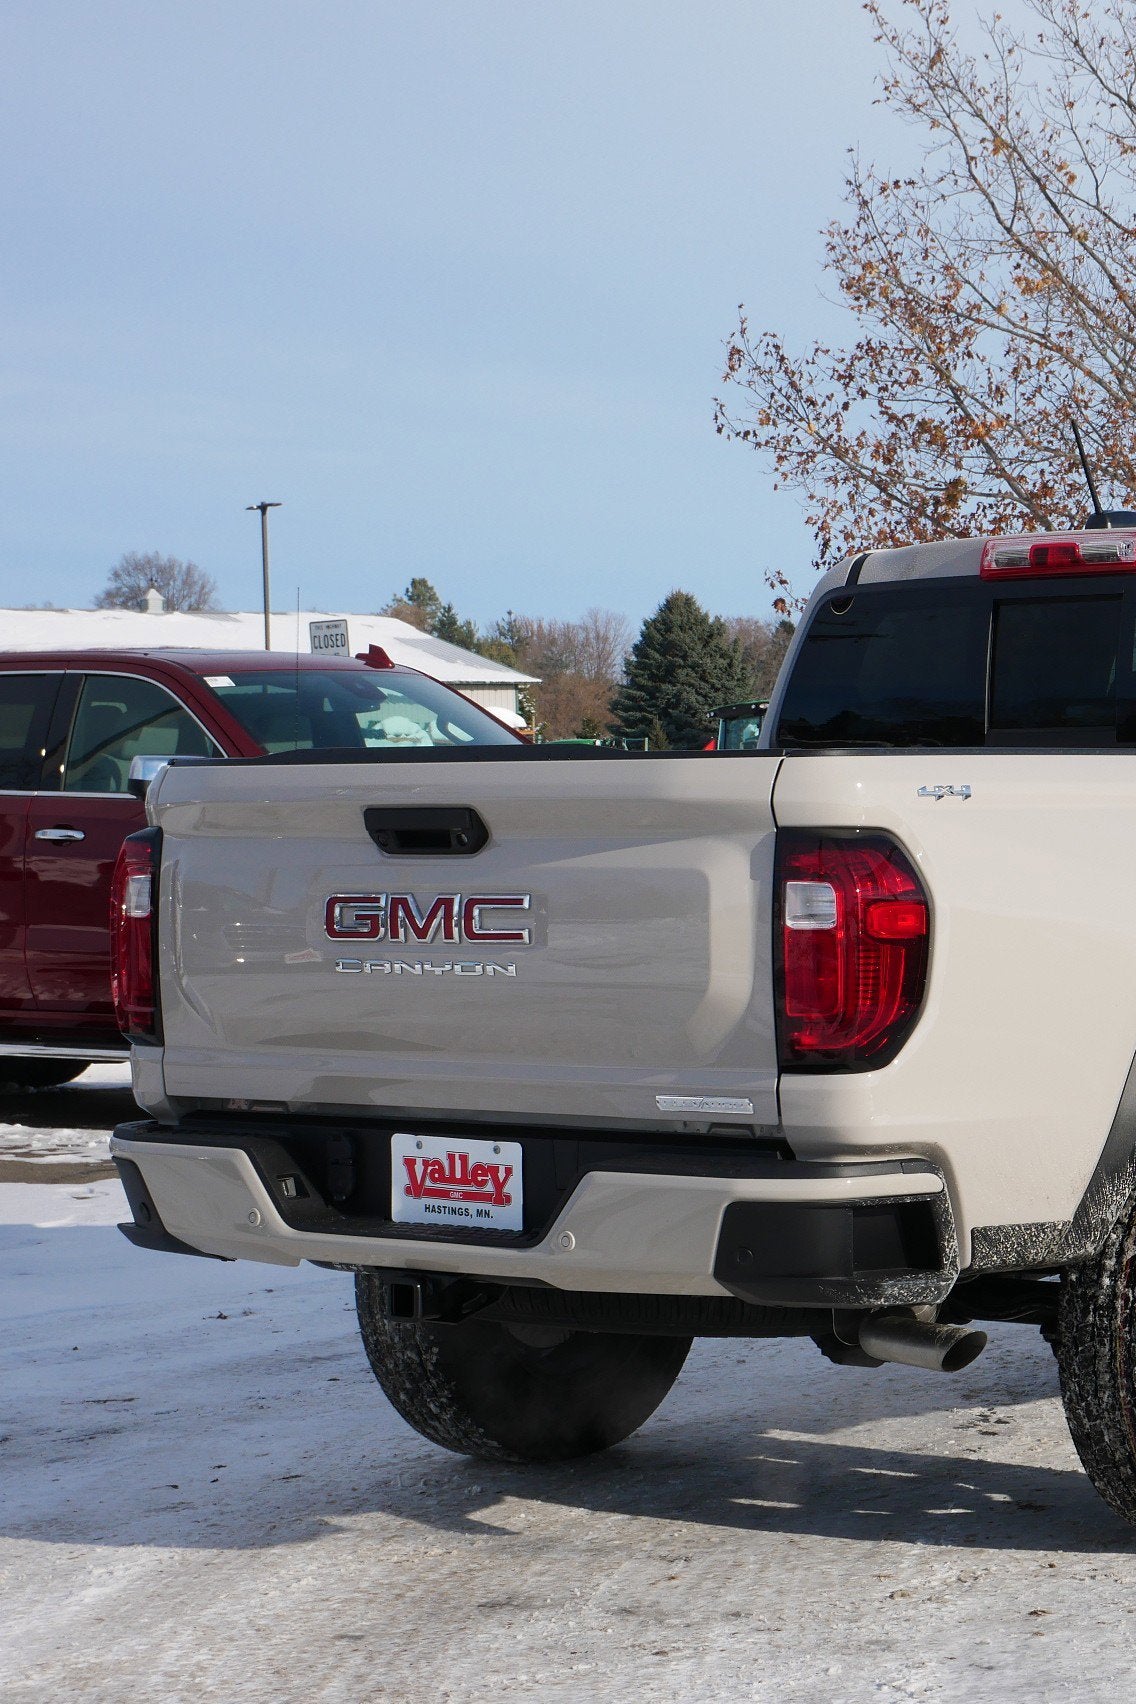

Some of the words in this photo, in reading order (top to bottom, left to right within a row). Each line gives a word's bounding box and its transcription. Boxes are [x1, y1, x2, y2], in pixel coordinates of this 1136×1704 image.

[313, 633, 346, 649] CLOSED
[325, 892, 531, 946] GMC
[335, 957, 518, 977] CANYON
[449, 1191, 464, 1200] GMC
[424, 1203, 473, 1219] HASTINGS,
[476, 1208, 494, 1219] MN.
